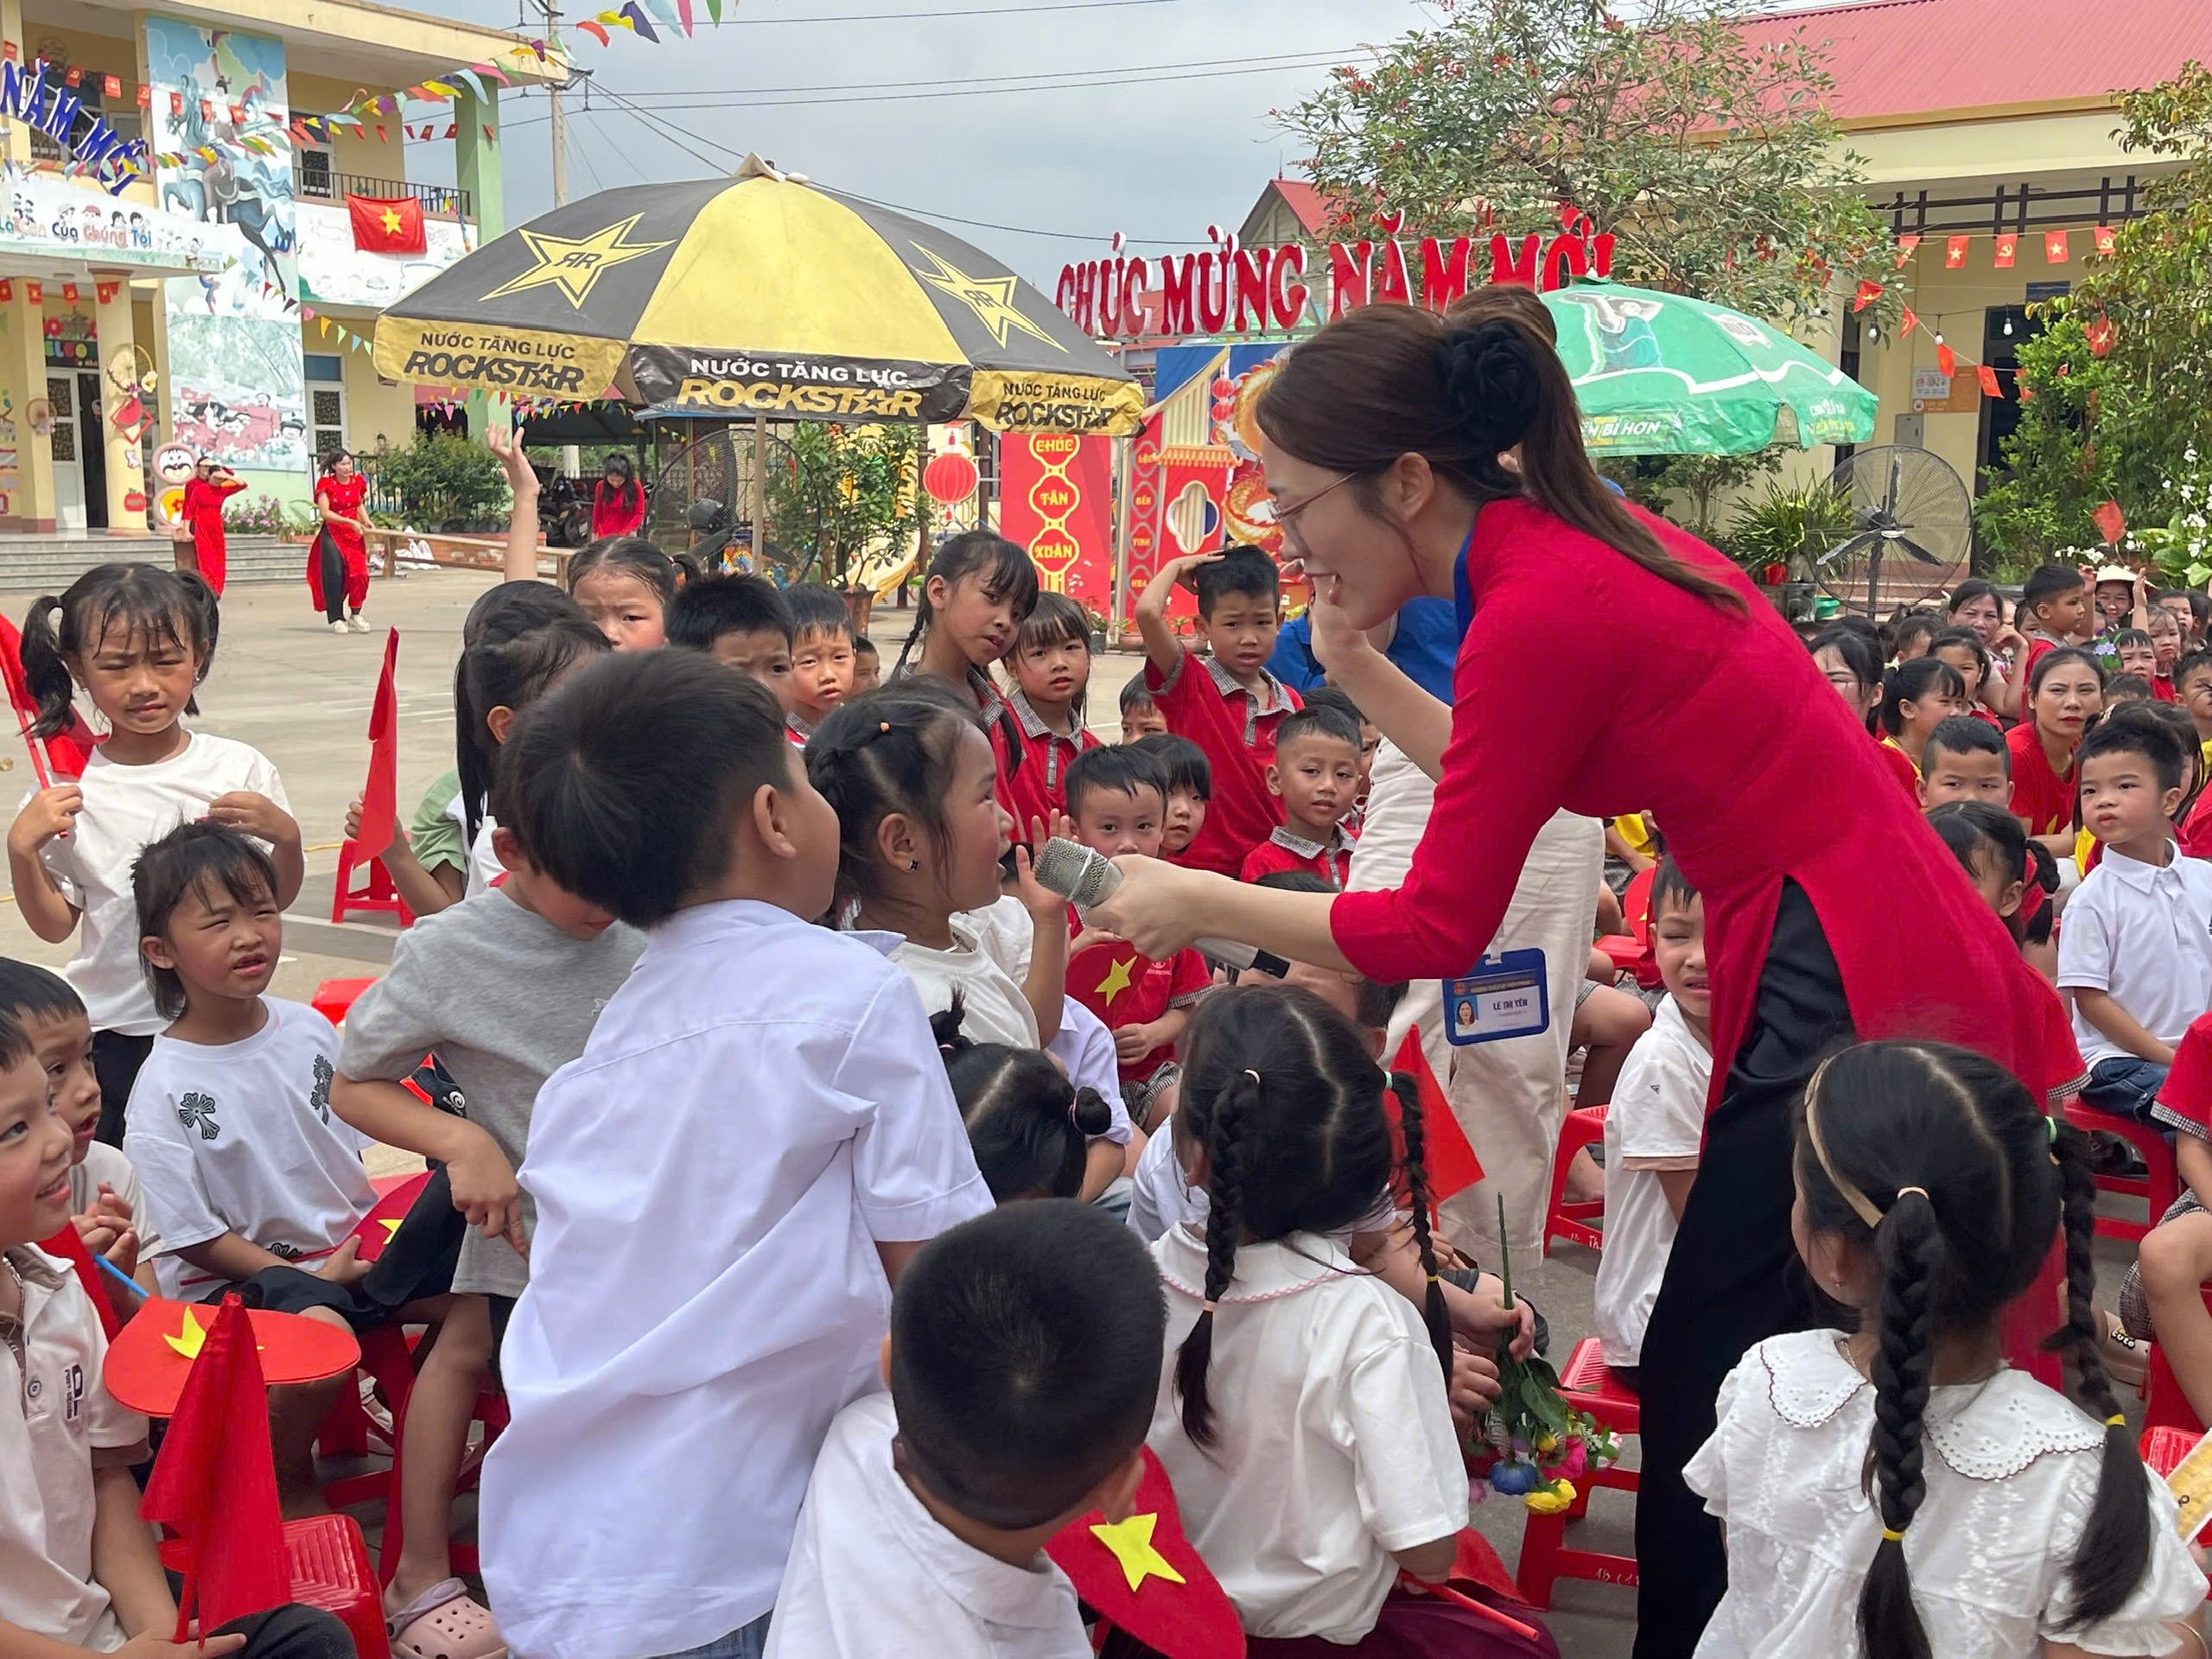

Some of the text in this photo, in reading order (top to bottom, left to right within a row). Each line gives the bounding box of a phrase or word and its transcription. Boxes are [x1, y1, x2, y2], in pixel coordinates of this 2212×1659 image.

[1056, 206, 1618, 338] CHÚC MỪNG NĂM MỚI
[421, 332, 575, 362] NƯỚC TĂNG LỰC
[404, 351, 584, 393] ROCKSTAR
[691, 359, 908, 387] NƯỚC TĂNG LỰC
[676, 378, 923, 417] ROCKSTAR
[1003, 380, 1042, 397] NƯỚC
[1046, 382, 1081, 398] TĂNG
[995, 402, 1116, 429] ROCKSTAR
[1036, 436, 1074, 453] CHÚC
[1040, 489, 1069, 506] TÂN
[1035, 542, 1073, 558] XUÂN
